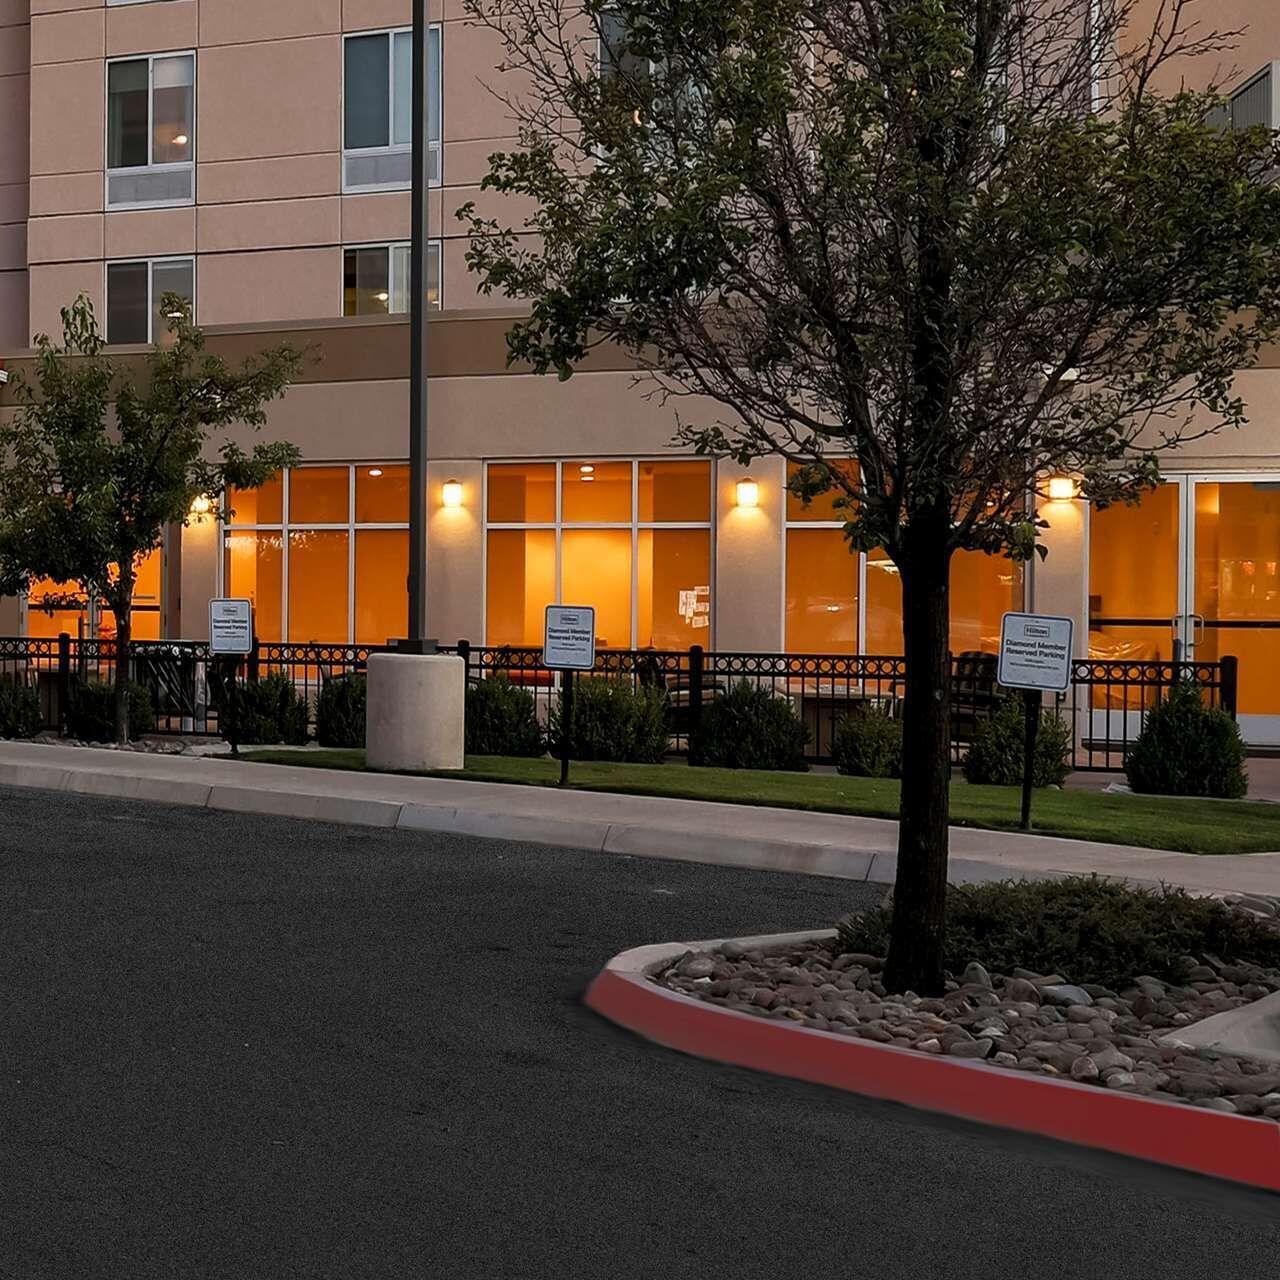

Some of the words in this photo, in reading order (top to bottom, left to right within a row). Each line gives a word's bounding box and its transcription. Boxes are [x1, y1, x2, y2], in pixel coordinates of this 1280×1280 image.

[1026, 627, 1048, 635] Hilton
[1006, 639, 1037, 648] Diamond
[1038, 642, 1066, 651] Member
[1006, 647, 1038, 656] Reserved
[1039, 650, 1065, 660] Parking
